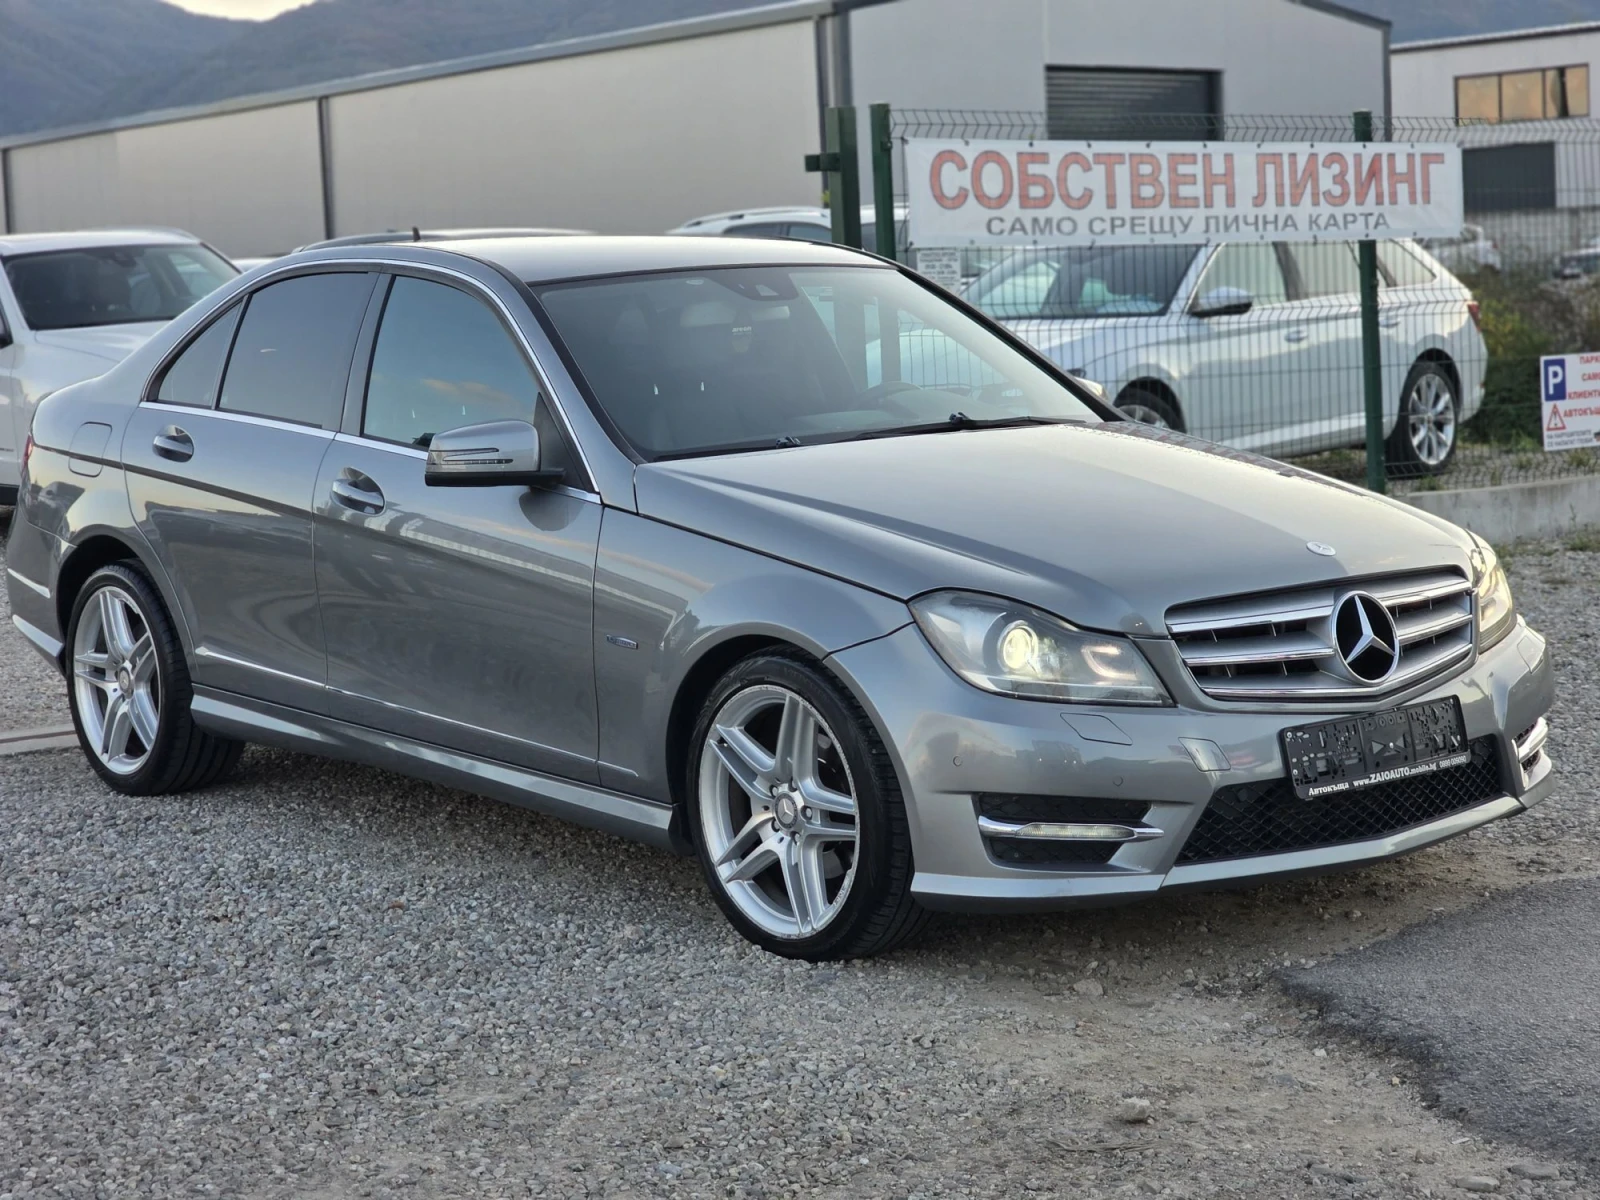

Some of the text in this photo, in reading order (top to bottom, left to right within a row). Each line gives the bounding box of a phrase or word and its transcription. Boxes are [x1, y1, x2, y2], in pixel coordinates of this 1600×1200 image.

[929, 149, 1445, 210] СОБСТВЕН ЛИЗИНГ
[986, 212, 1390, 239] САМО СРЕЩУ ЛИЧНА КАРТА
[1548, 365, 1563, 395] P
[1308, 782, 1350, 796] Автокъща
